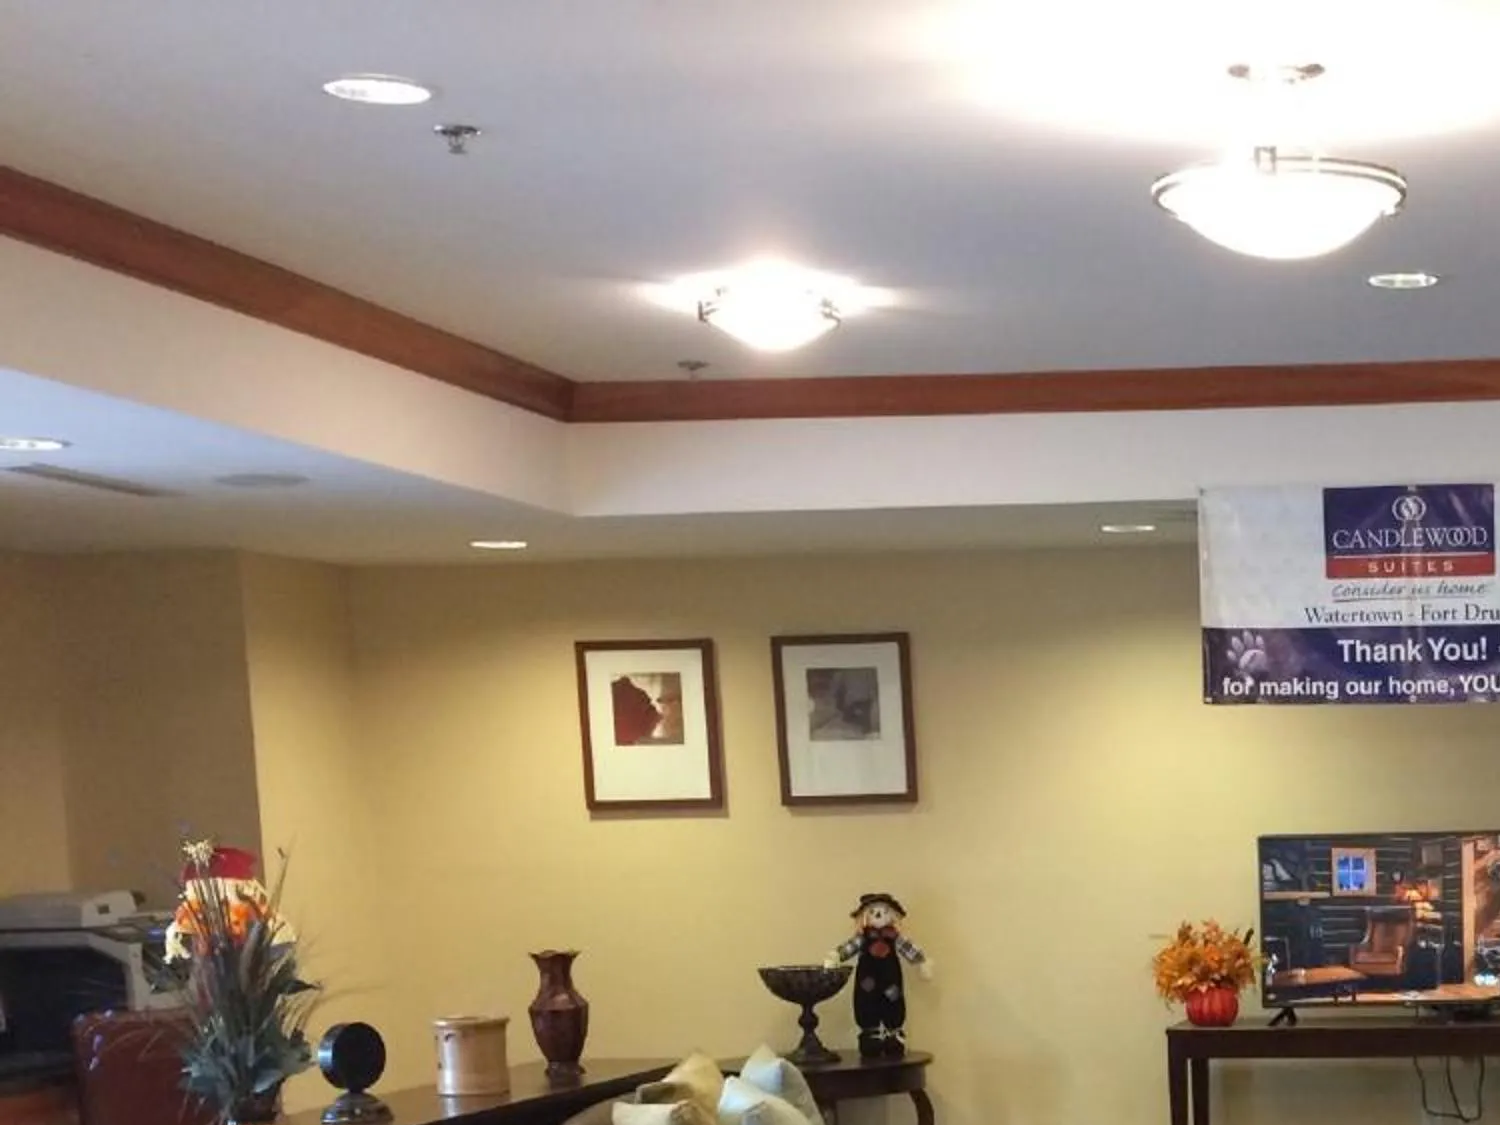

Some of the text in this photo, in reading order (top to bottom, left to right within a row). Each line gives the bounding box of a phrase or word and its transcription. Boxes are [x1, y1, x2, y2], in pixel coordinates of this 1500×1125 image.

[1331, 525, 1489, 549] CANDLEWOOD
[1367, 559, 1455, 574] SUITES
[1411, 584, 1432, 596] us
[1436, 580, 1490, 596] home
[1304, 604, 1404, 624] Watertown
[1420, 603, 1458, 622] Fort
[1337, 635, 1488, 663] Thank You!
[1222, 676, 1255, 696] for
[1259, 676, 1339, 700] making
[1345, 679, 1383, 696] our
[1388, 675, 1456, 697] home,
